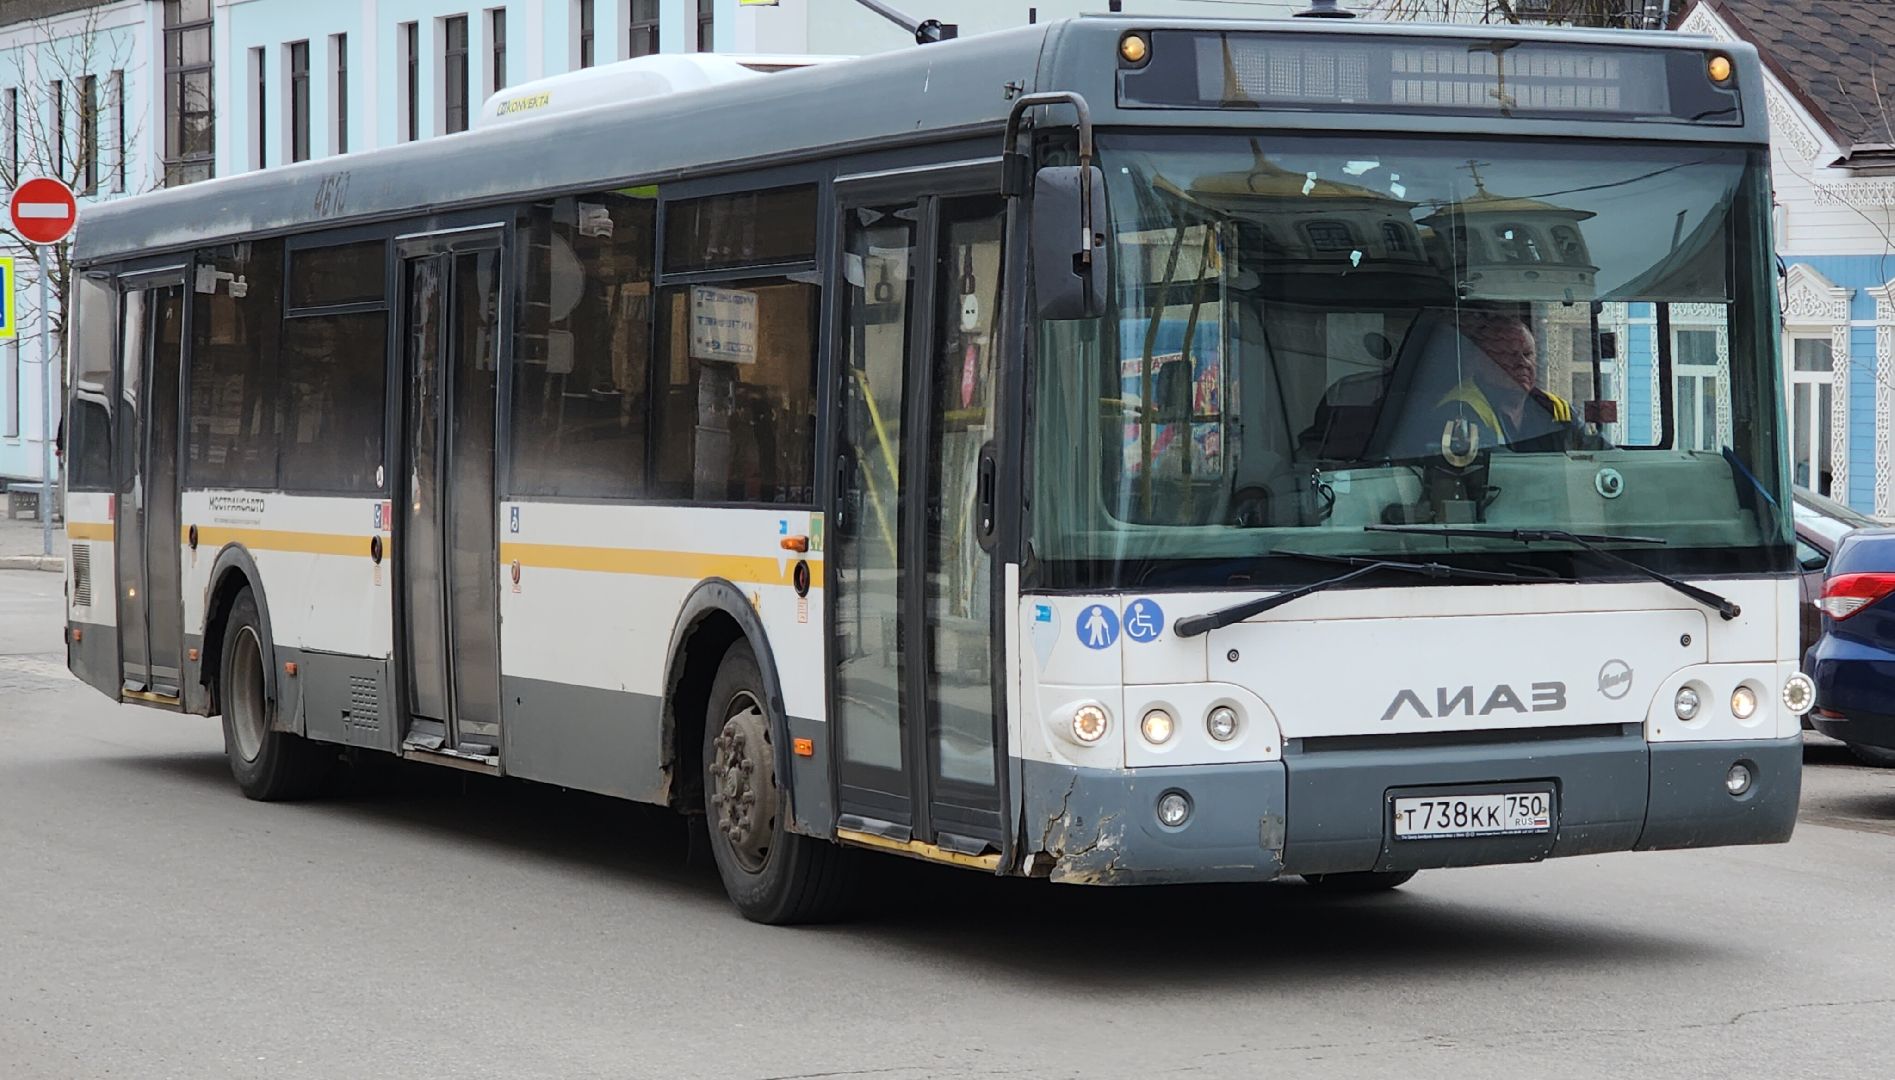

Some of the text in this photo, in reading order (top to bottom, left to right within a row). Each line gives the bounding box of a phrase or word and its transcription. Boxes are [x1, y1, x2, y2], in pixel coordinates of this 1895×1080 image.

[1380, 681, 1567, 721] ЛИАЗ
[1507, 796, 1542, 818] 750
[1515, 818, 1534, 827] RUS
